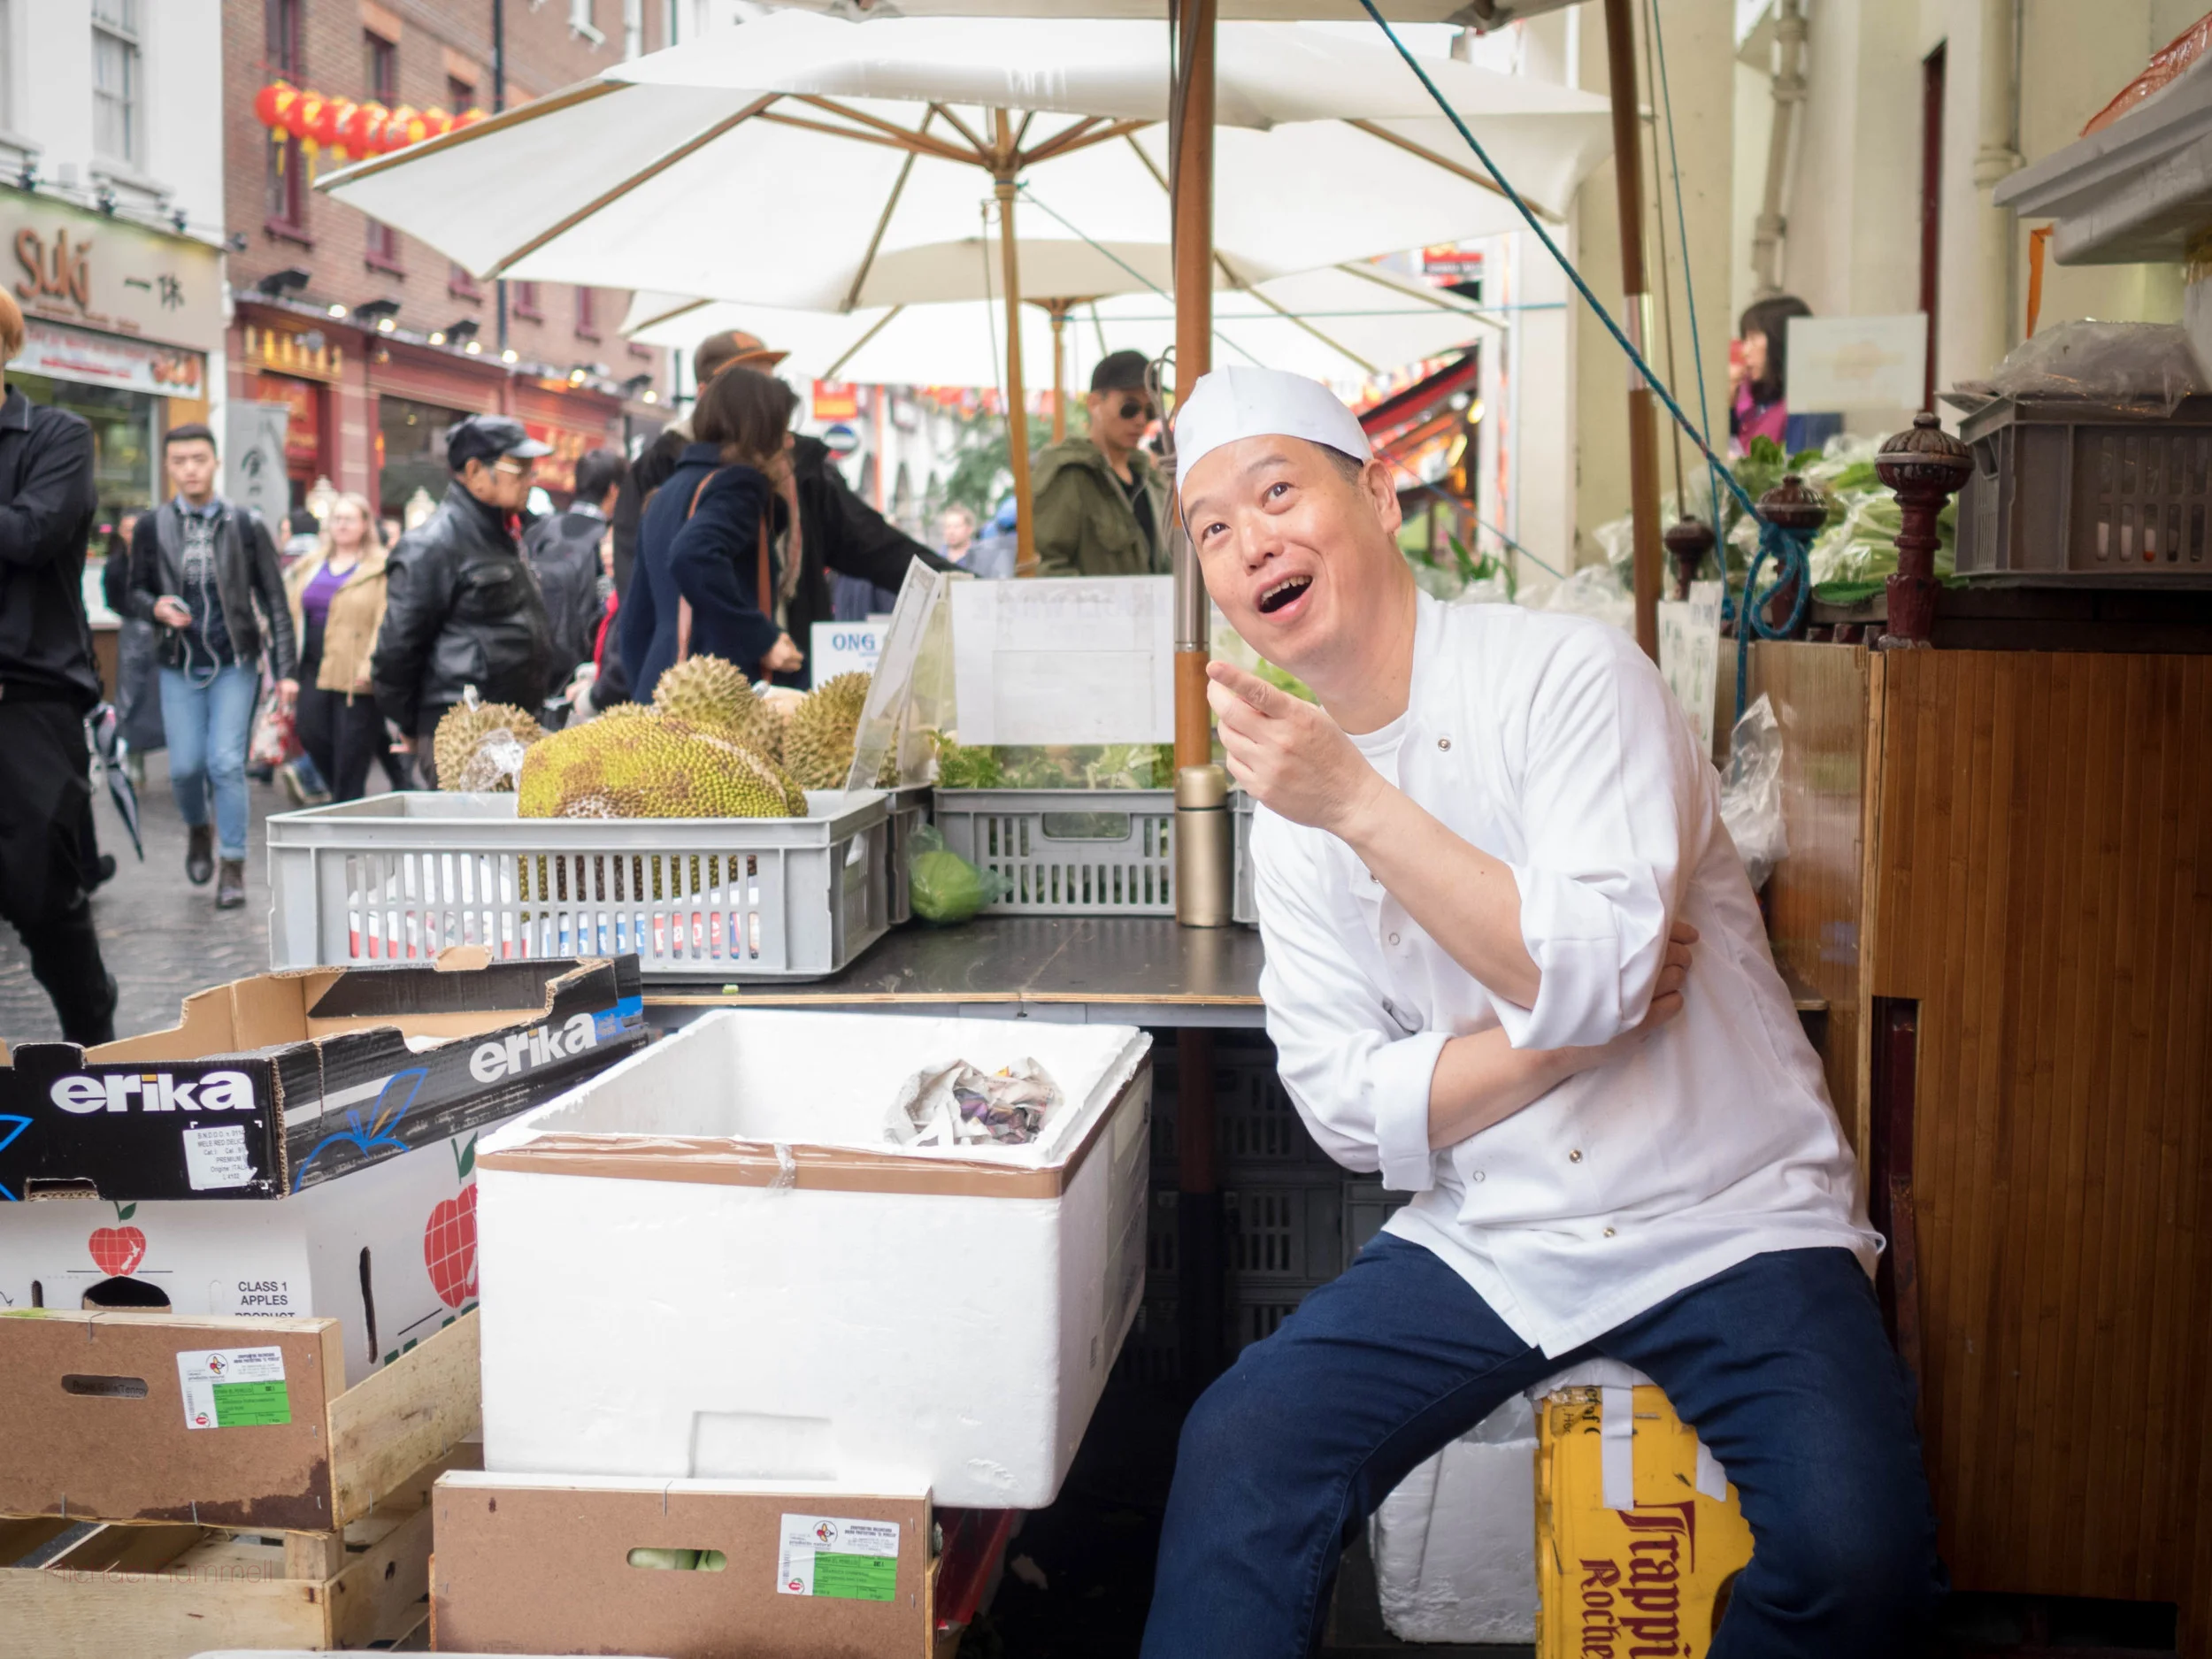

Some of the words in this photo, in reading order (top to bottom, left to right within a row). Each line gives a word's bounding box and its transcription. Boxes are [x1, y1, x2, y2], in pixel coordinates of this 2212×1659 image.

[832, 634, 876, 651] ONG
[469, 1012, 598, 1084] erika
[50, 1071, 257, 1114] erika
[238, 1281, 279, 1292] CLASS
[281, 1281, 288, 1292] 1
[240, 1294, 288, 1306] APPLES
